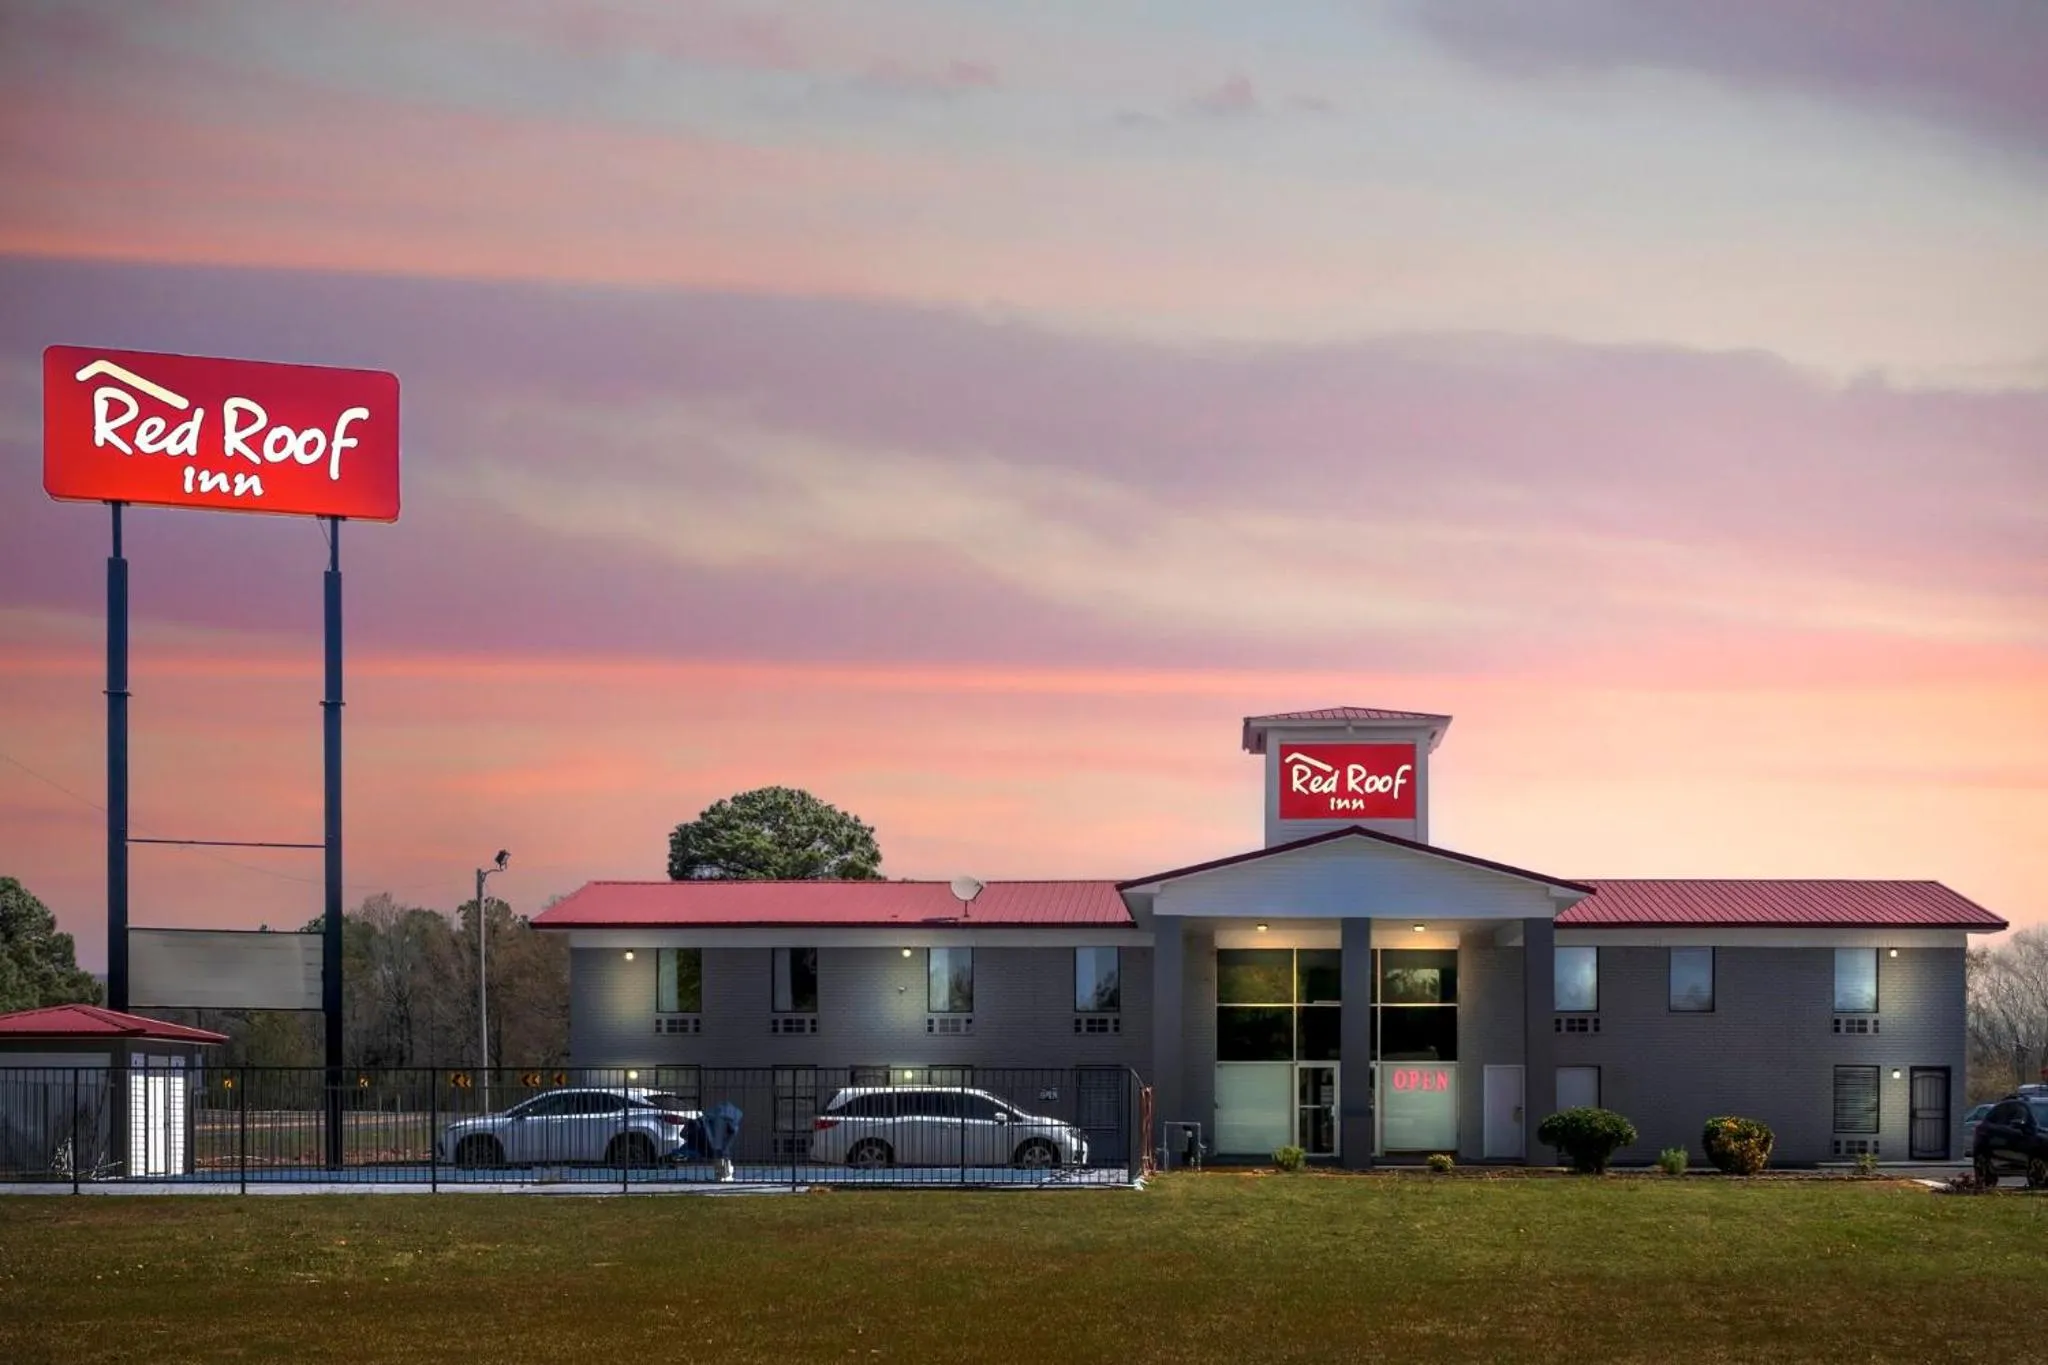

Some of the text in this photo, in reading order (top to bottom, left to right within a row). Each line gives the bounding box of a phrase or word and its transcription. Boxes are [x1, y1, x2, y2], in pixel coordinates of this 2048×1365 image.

[93, 387, 370, 481] Red Roof
[1292, 764, 1412, 799] Red Roof
[1393, 1070, 1449, 1090] OPEN
